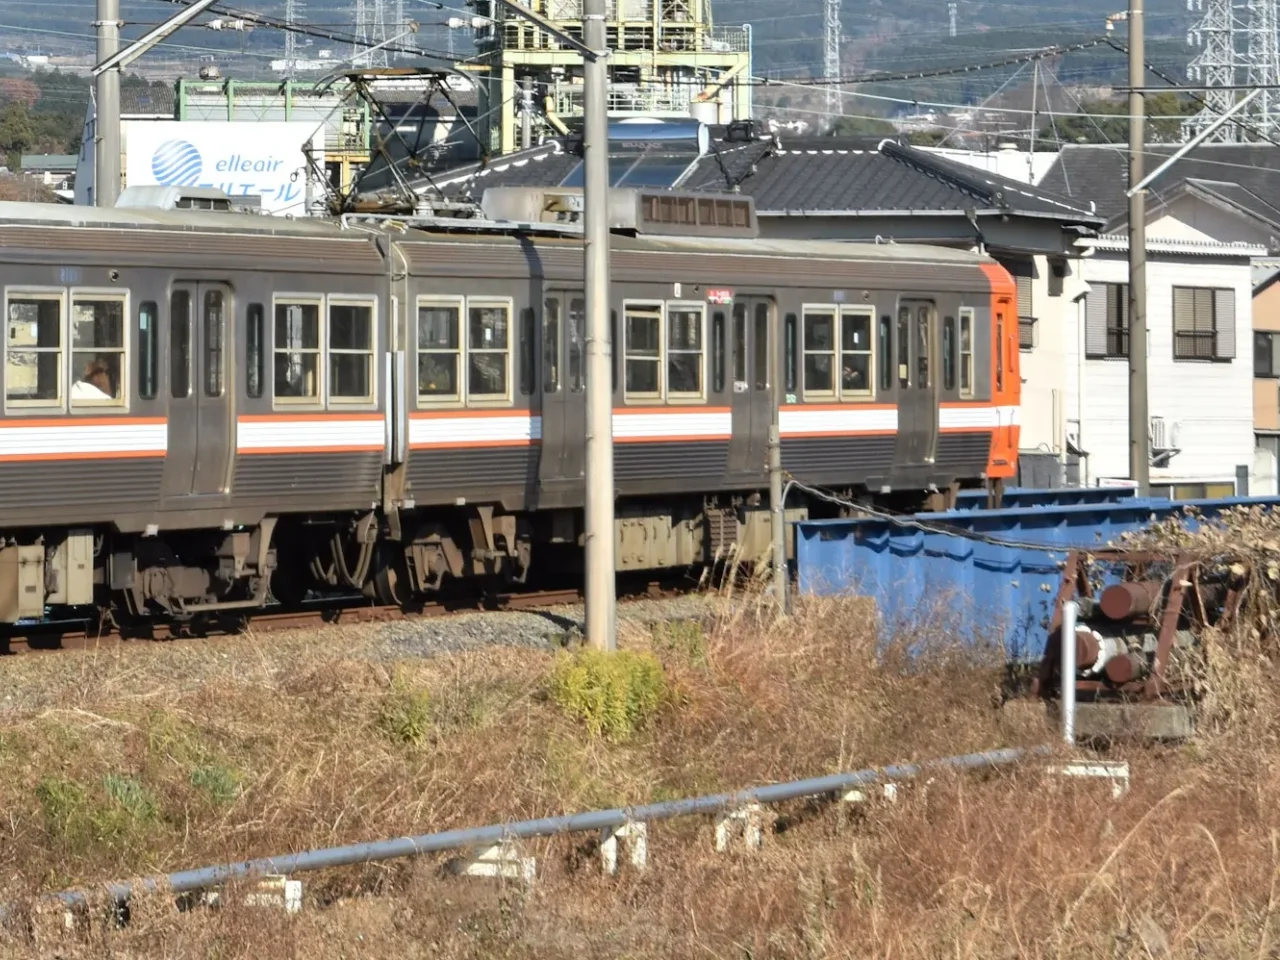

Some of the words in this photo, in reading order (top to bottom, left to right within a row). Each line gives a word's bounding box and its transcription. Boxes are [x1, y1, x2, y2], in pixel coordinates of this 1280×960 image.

[216, 154, 284, 172] elleair
[199, 183, 301, 202] リエール
